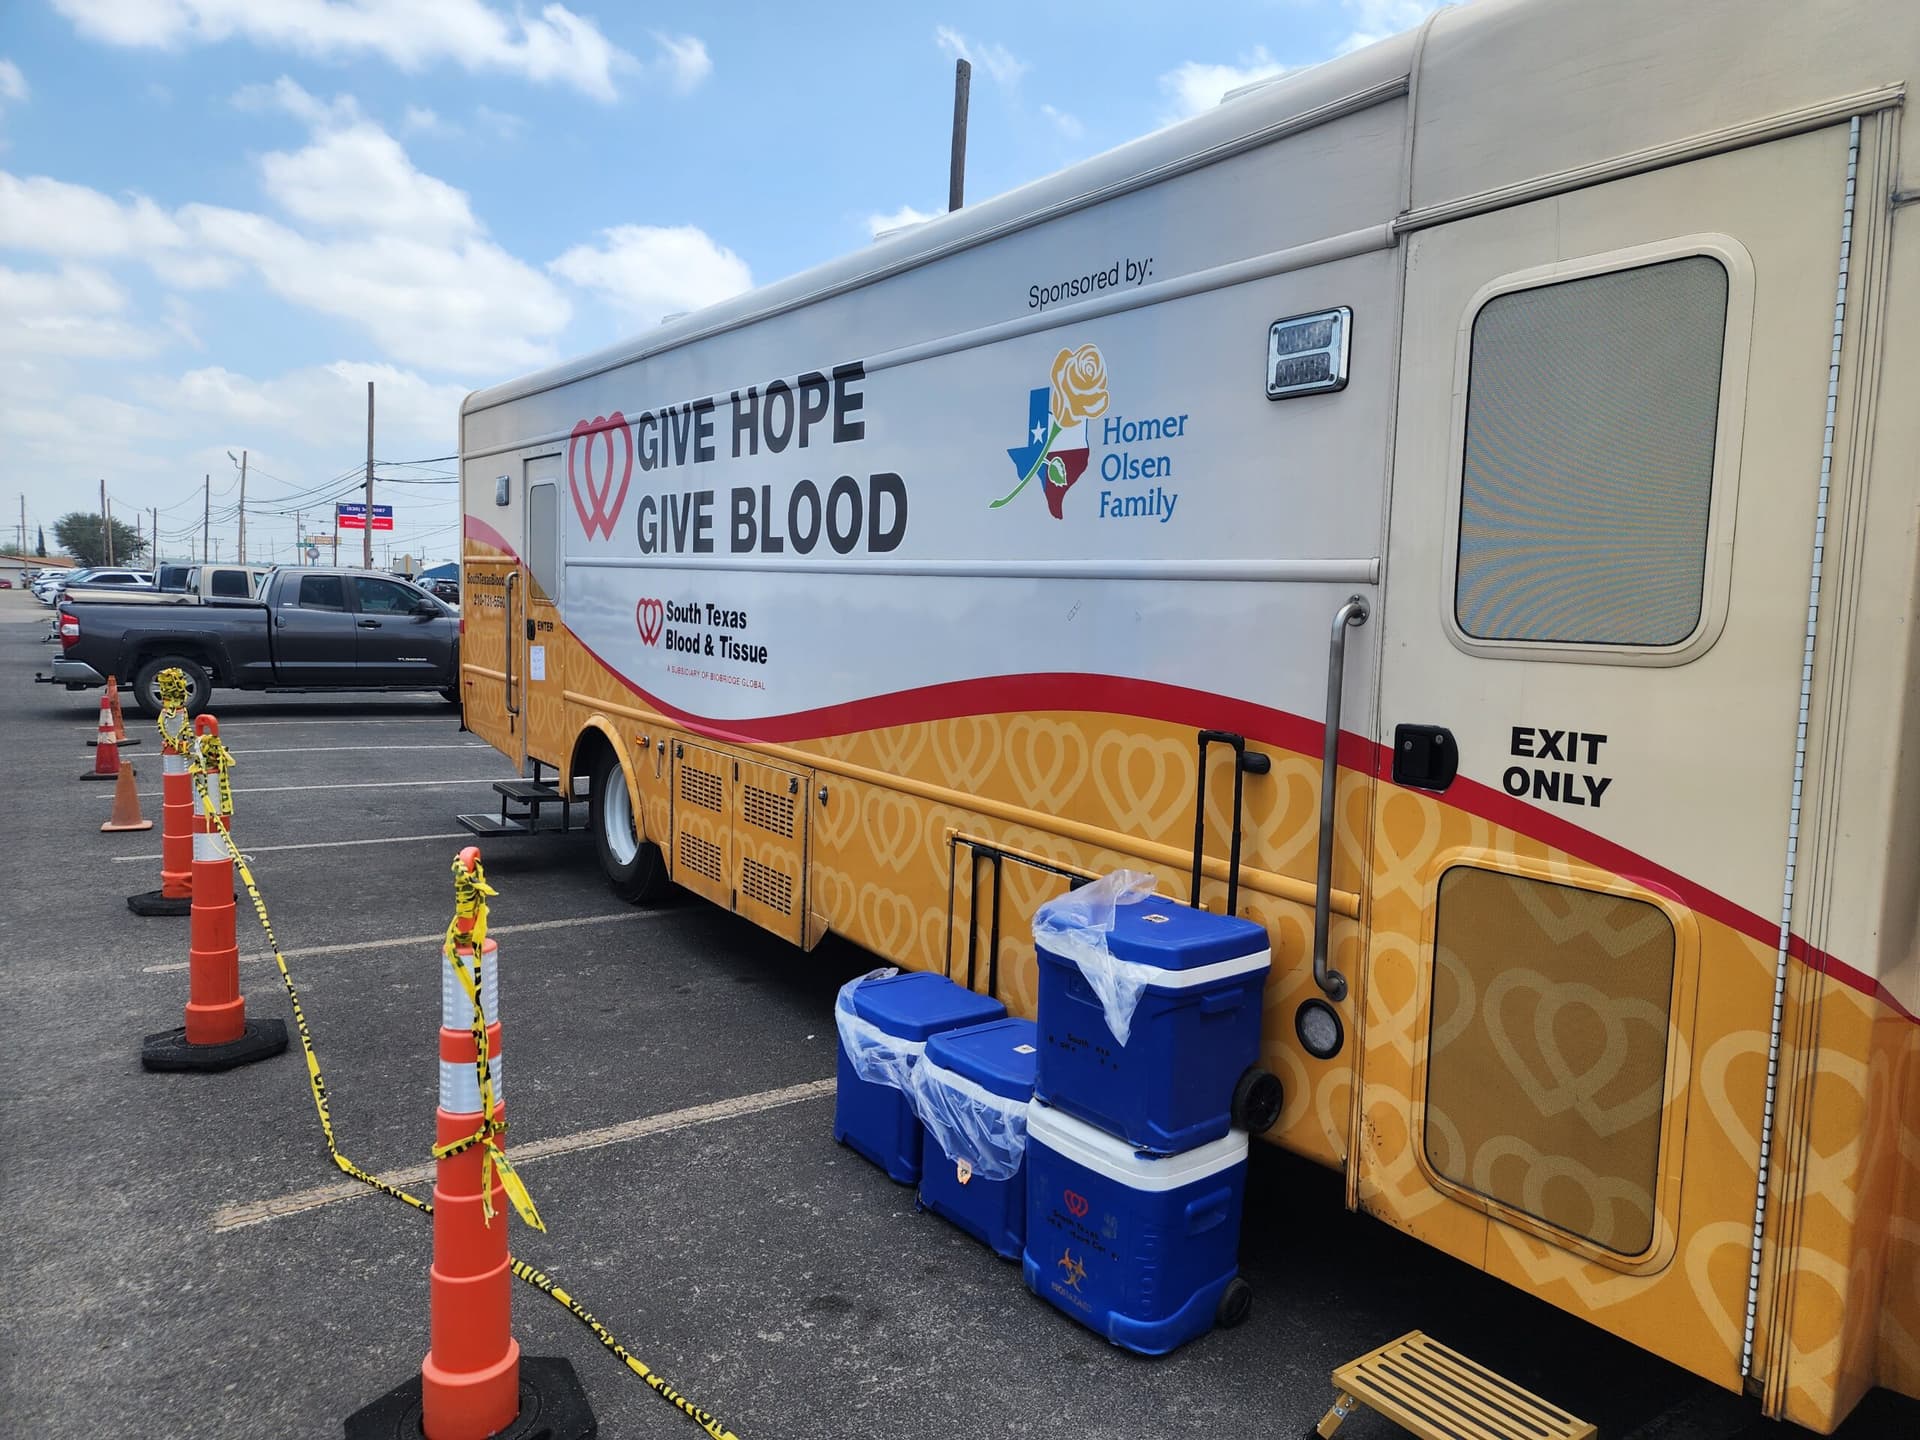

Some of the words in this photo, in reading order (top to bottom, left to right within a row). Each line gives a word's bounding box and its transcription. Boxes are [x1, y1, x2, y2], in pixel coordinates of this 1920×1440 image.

[1028, 261, 1119, 311] Sponsored
[1125, 257, 1153, 285] by:
[637, 397, 715, 472] GIVE
[730, 360, 866, 458] HOPE
[1103, 413, 1188, 445] Homer
[1101, 452, 1171, 482] Olsen
[637, 489, 715, 554] GIVE
[730, 472, 908, 554] BLOOD
[1099, 487, 1178, 523] Family
[537, 620, 554, 632] ENTER
[666, 600, 701, 625] South
[706, 603, 747, 629] Texas
[665, 628, 700, 654] Blood
[704, 634, 715, 656] &
[719, 635, 768, 664] Tissue
[666, 664, 671, 673] A
[671, 665, 701, 677] SUBSIDIARY
[701, 670, 709, 679] OF
[710, 672, 741, 686] BIOBRIDGE
[741, 678, 766, 690] GLOBAL
[1510, 726, 1608, 765] EXIT
[1502, 766, 1613, 808] ONLY
